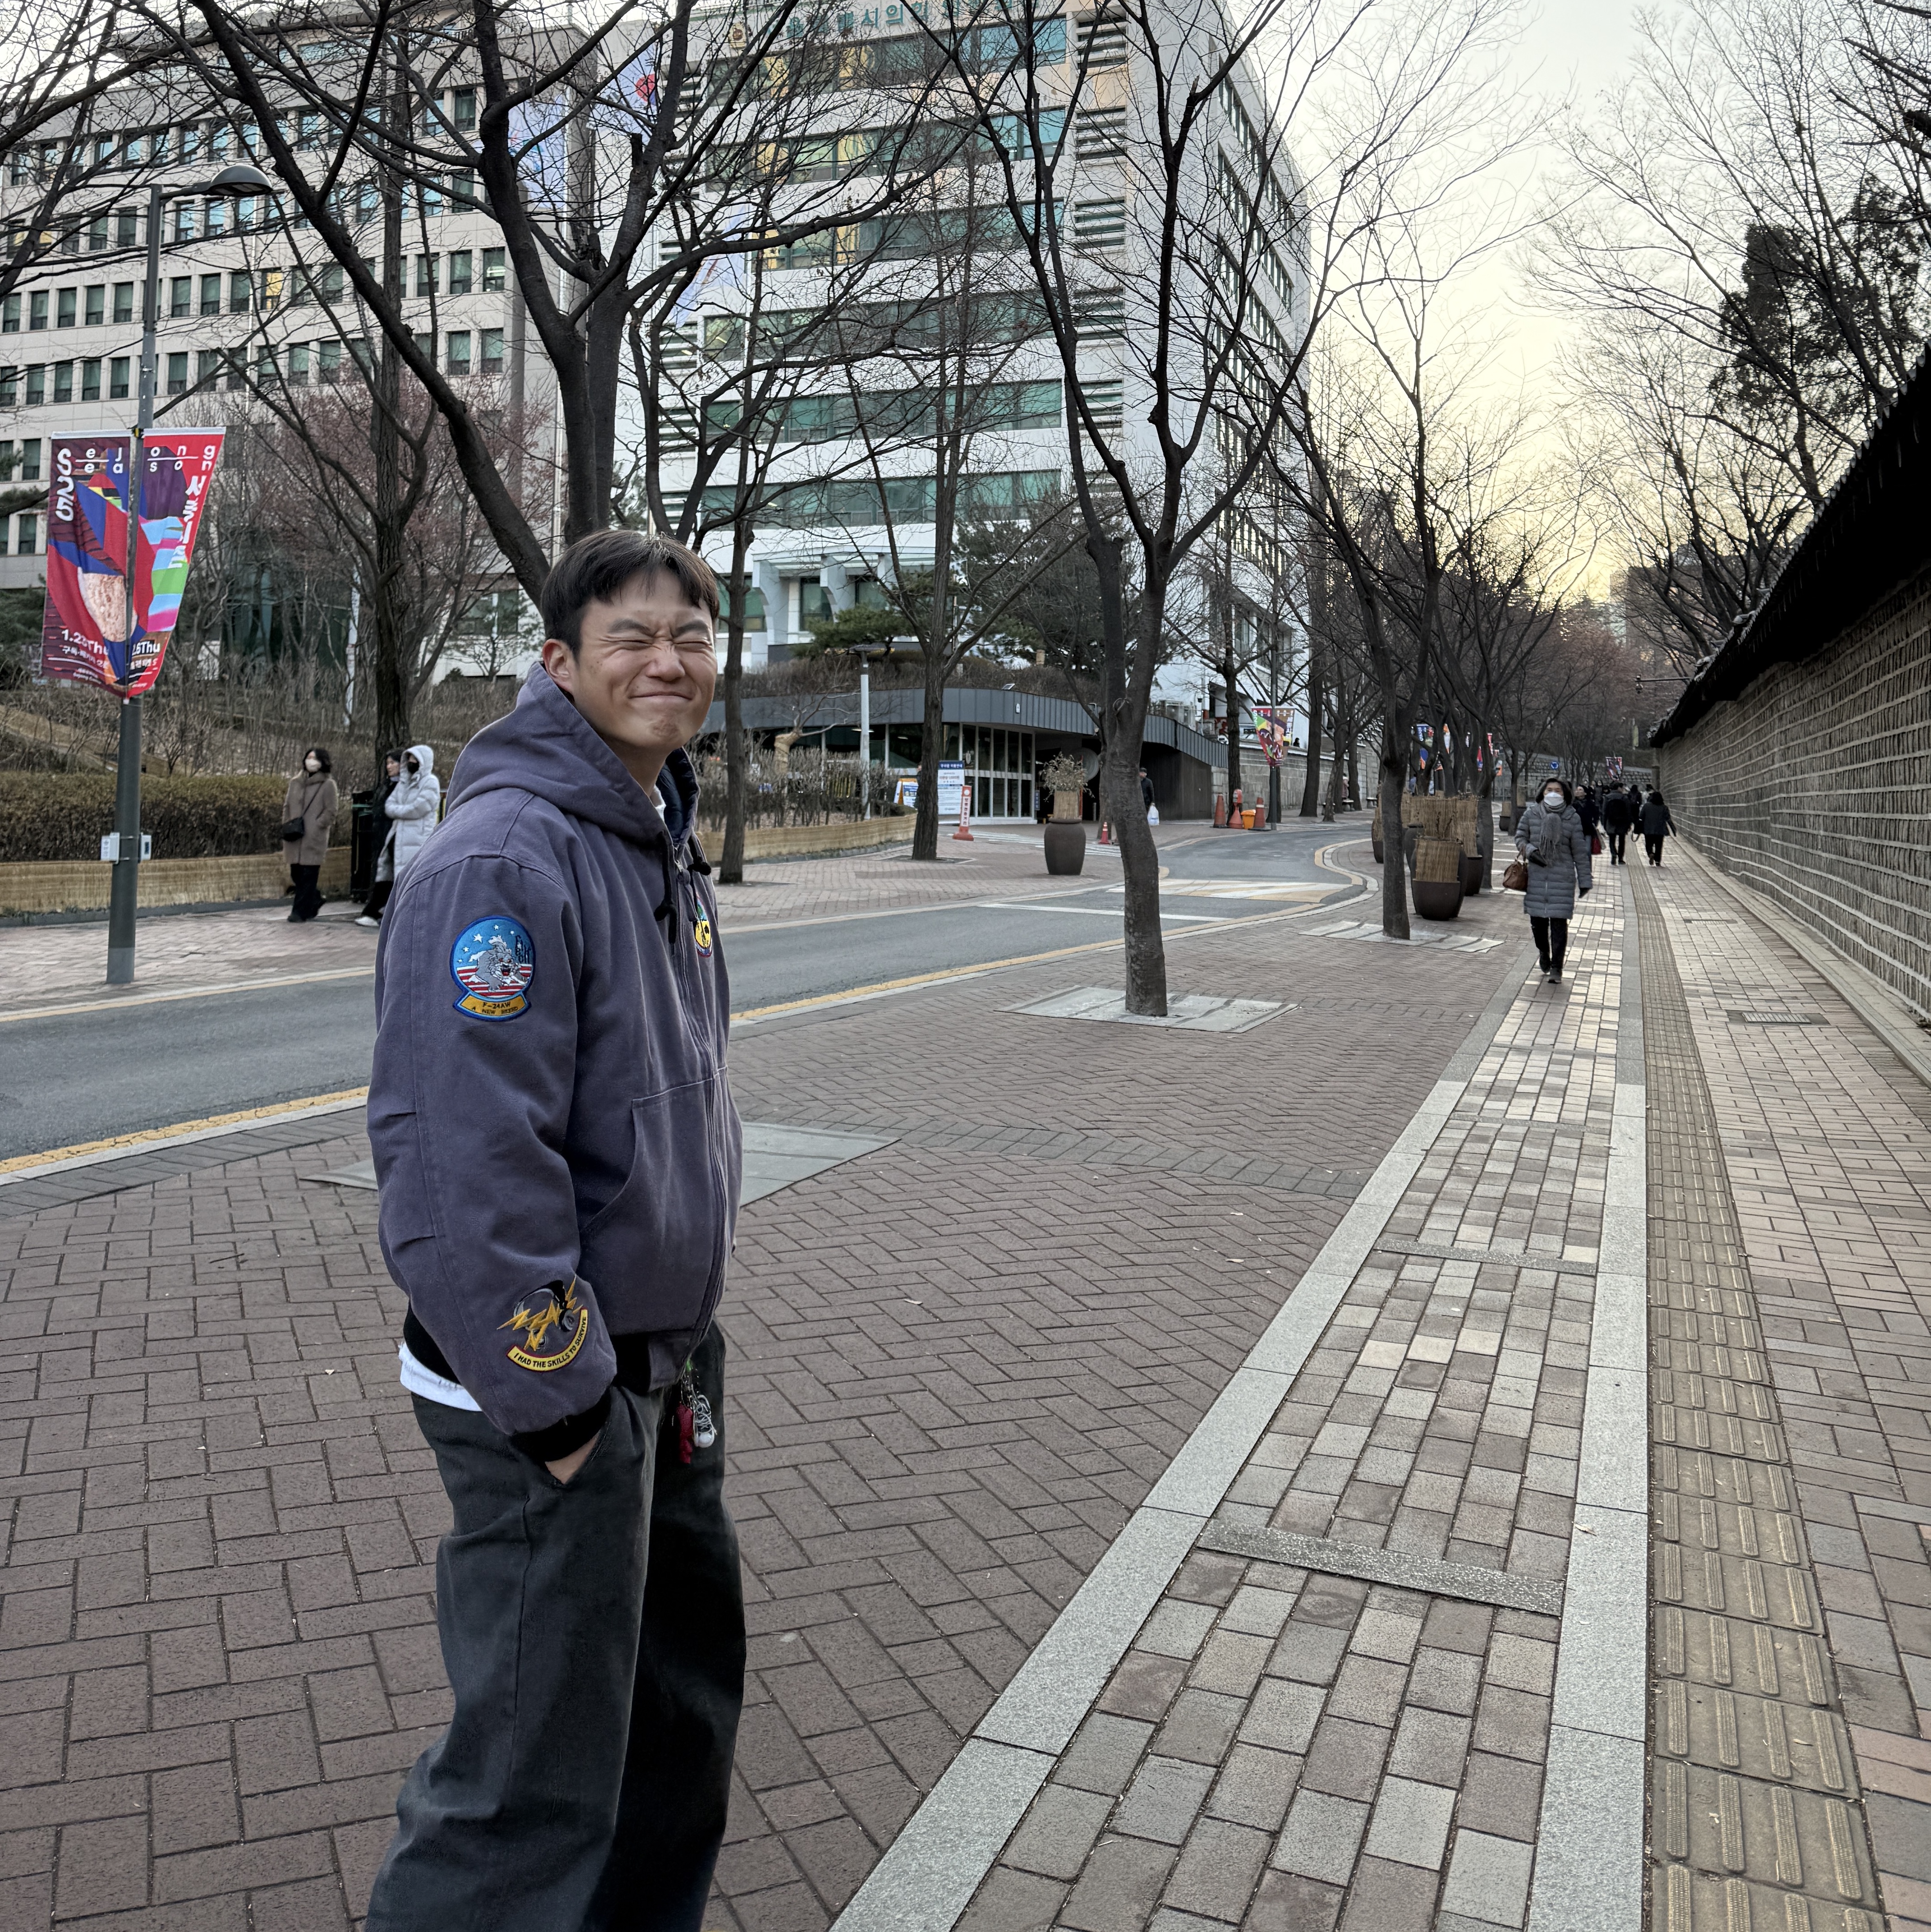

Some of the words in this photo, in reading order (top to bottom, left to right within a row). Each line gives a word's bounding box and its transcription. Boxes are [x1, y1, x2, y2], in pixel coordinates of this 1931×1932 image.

[518, 1356, 531, 1365] HAD
[547, 1353, 570, 1367] SKILLS
[569, 1346, 576, 1355] TO
[575, 1317, 586, 1346] SURVIVE
